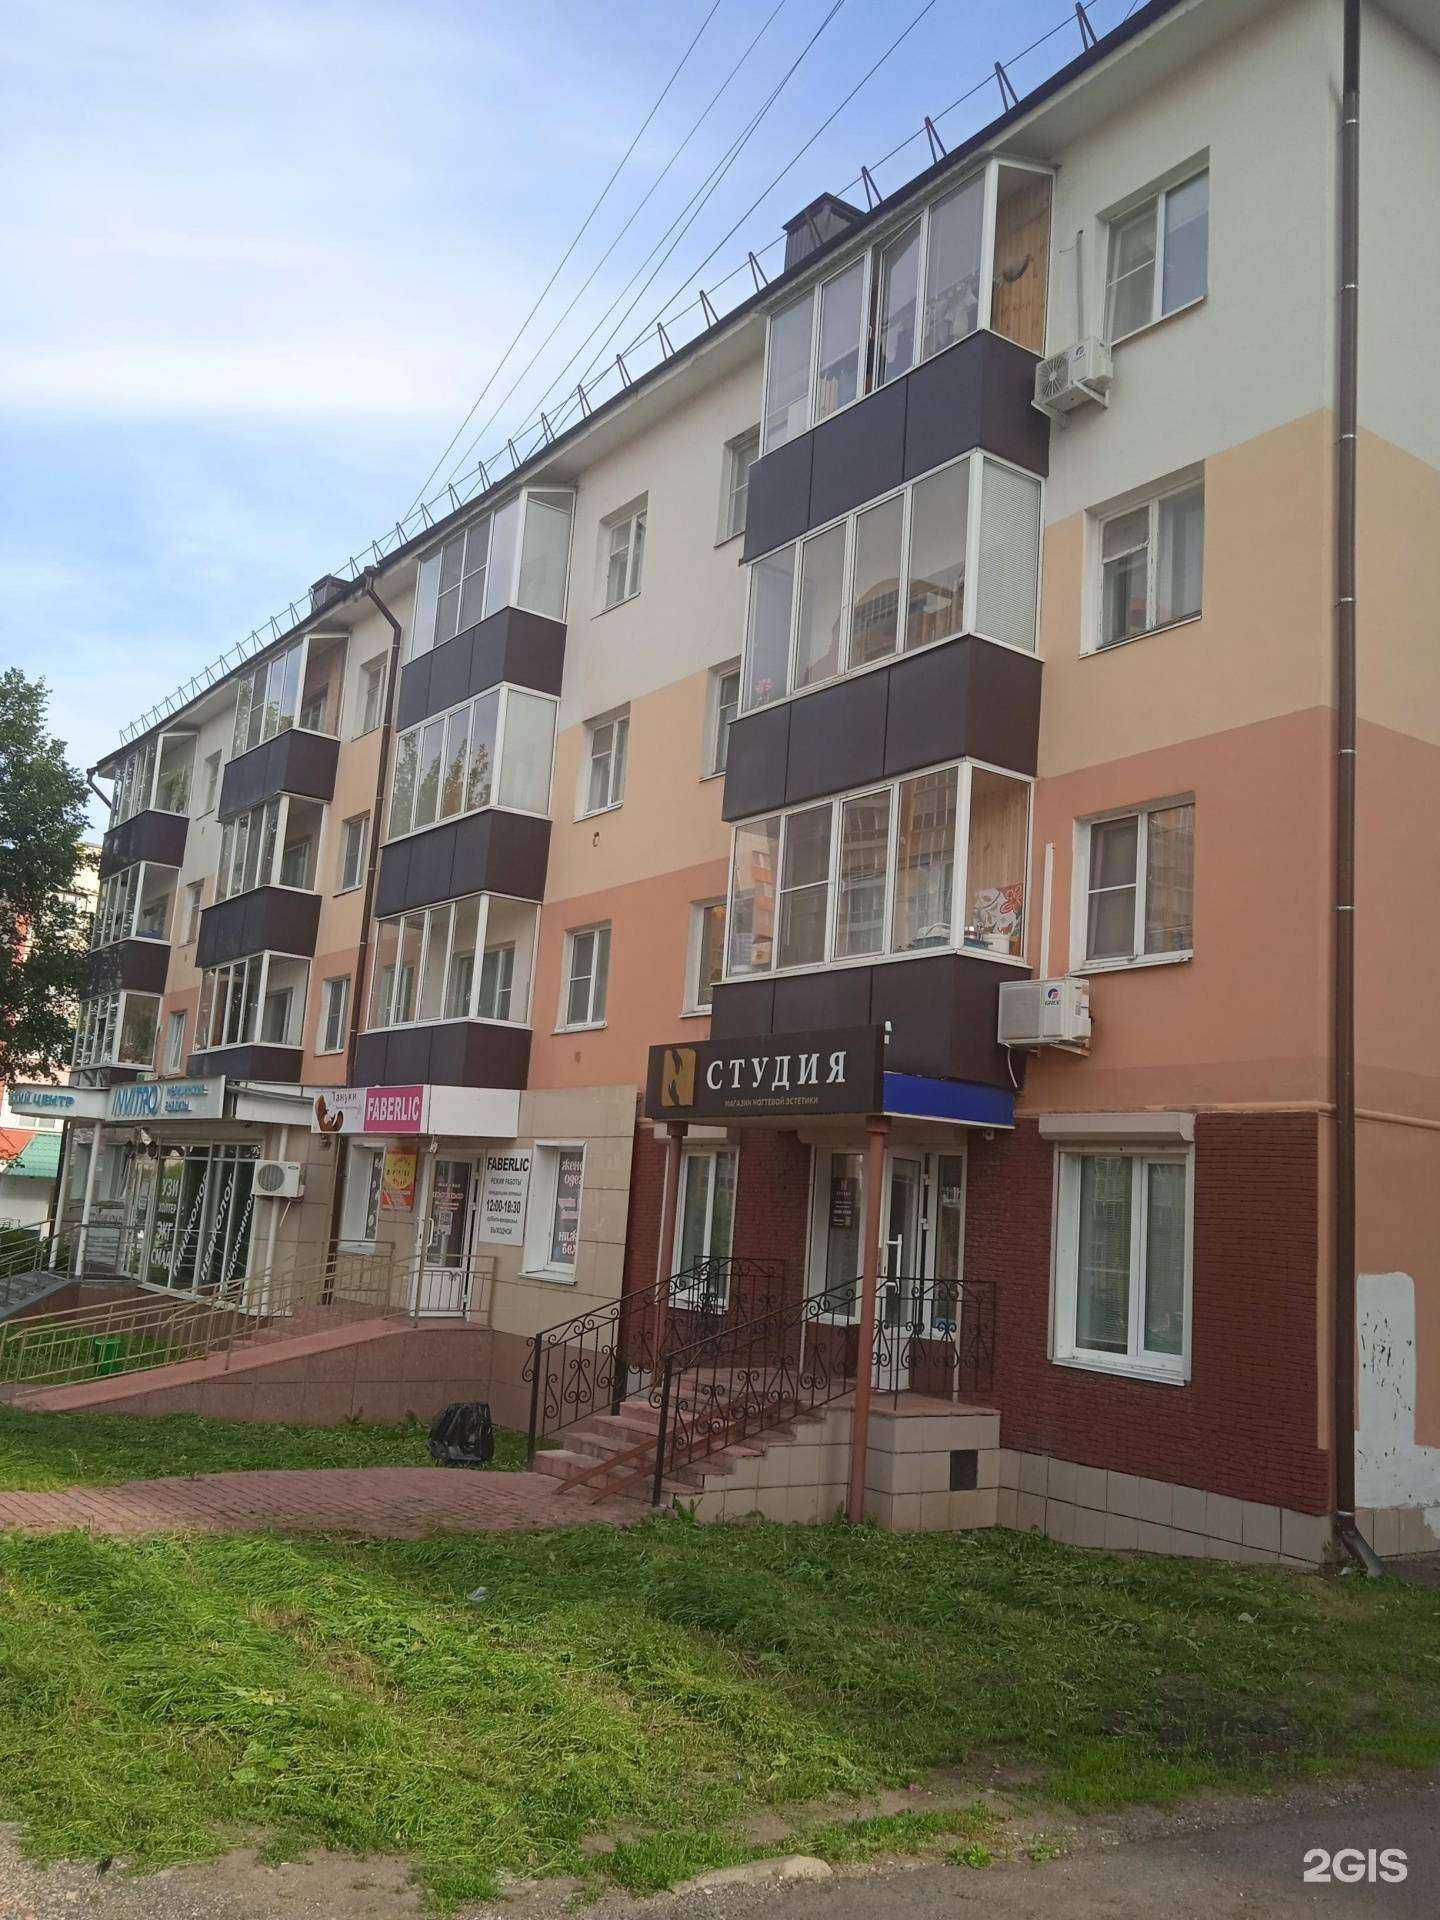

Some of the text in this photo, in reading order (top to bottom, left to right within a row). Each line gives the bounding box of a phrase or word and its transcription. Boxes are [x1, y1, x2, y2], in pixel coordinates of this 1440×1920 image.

[706, 1050, 847, 1091] СТУДИЯ
[112, 1084, 160, 1116] INVITRO
[367, 1096, 420, 1120] FABERLIC
[785, 1097, 818, 1105] ЭСТЕТИКИ
[487, 1157, 529, 1171] FABERLIC
[162, 1179, 179, 1197] УЗИ
[487, 1199, 521, 1213] 12:00-18:30
